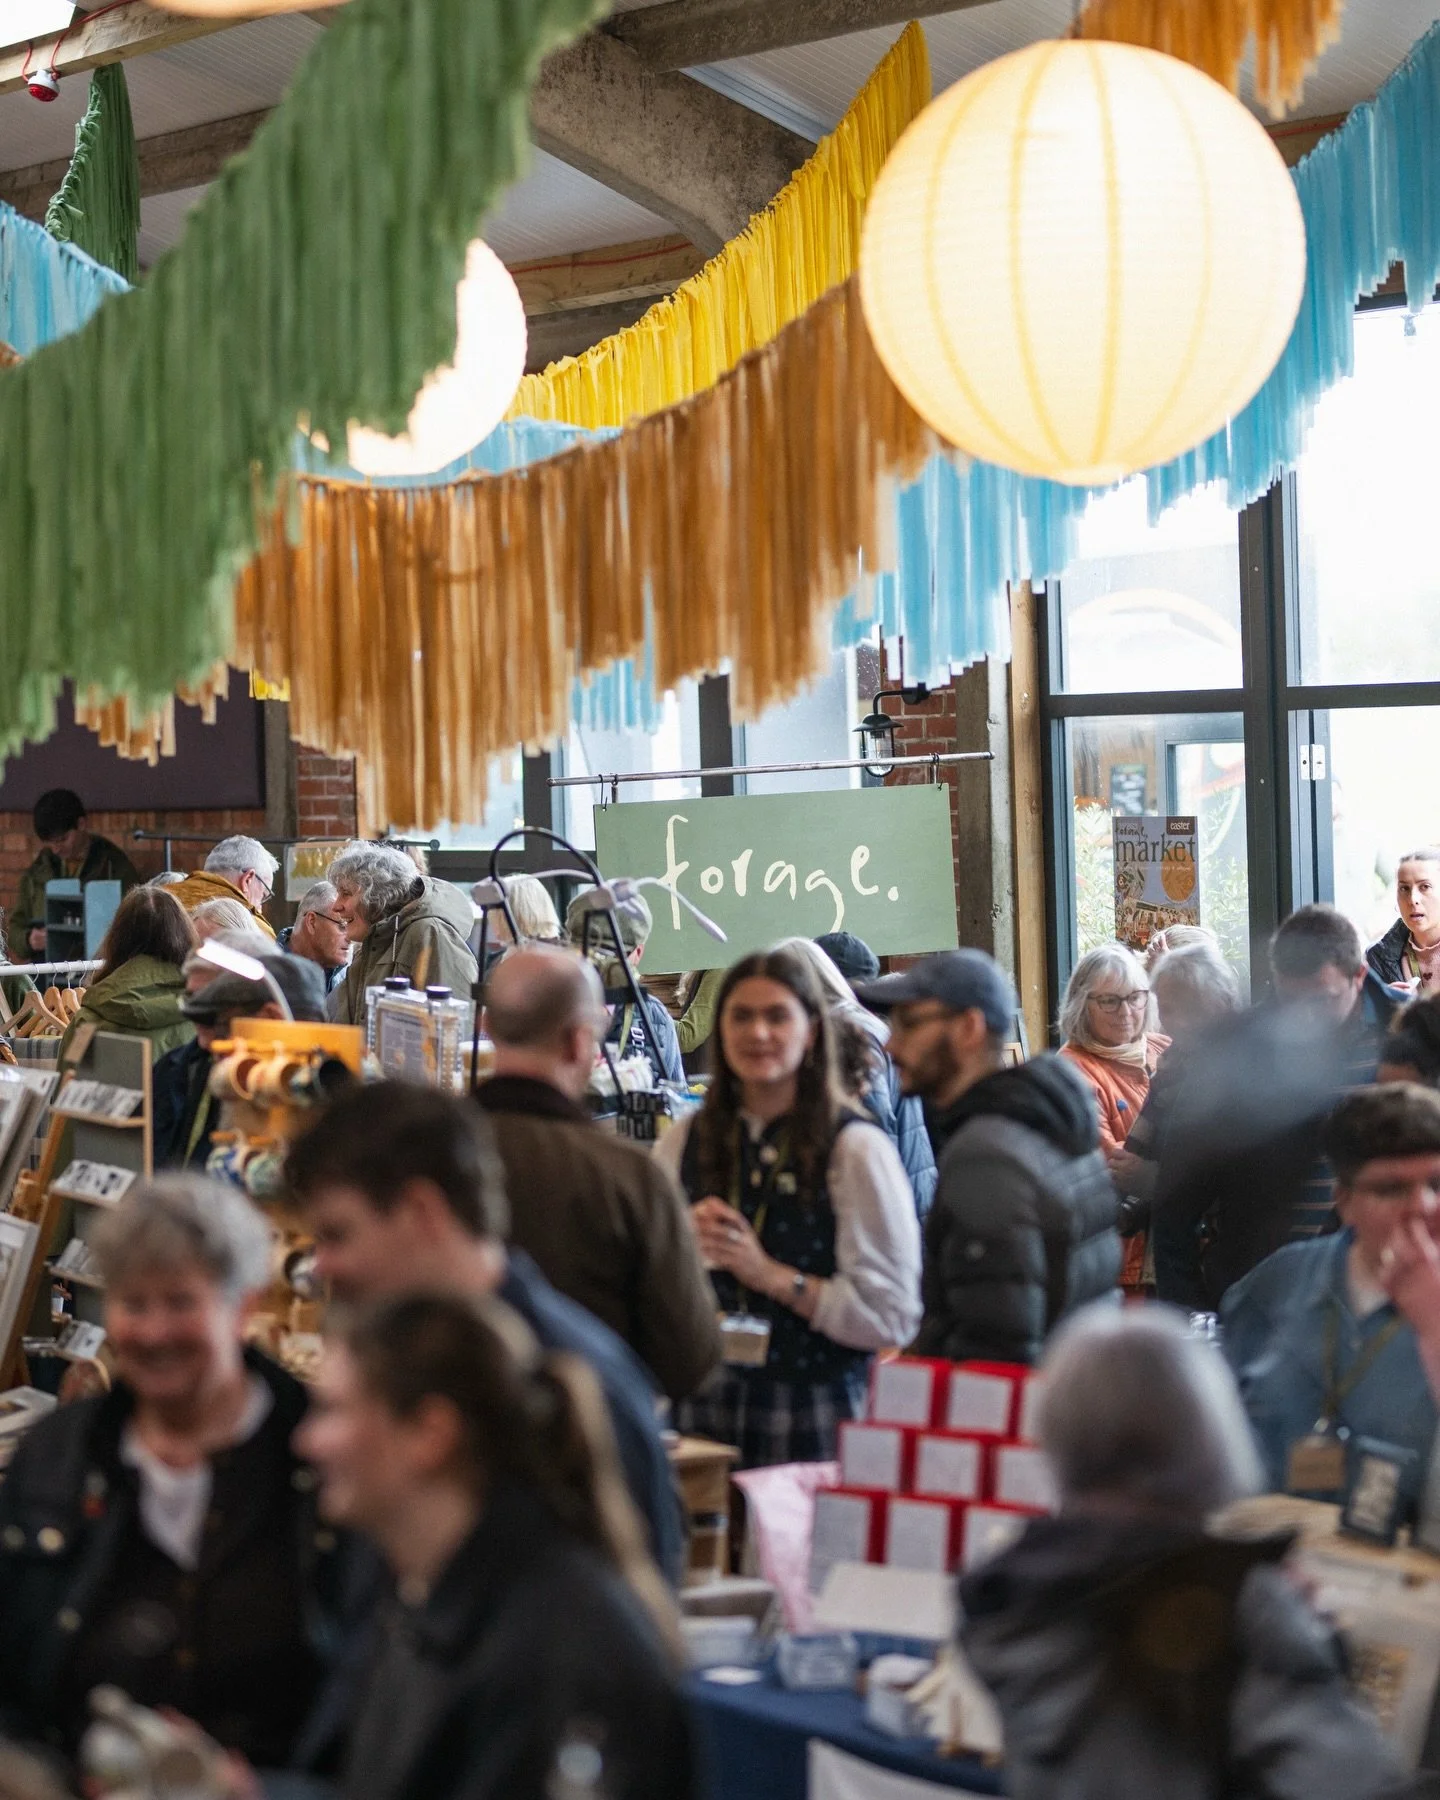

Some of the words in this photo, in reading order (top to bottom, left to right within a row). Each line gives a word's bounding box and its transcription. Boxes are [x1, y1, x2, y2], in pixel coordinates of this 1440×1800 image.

[1170, 822, 1190, 831] easter
[1115, 832, 1196, 862] market
[657, 814, 899, 933] forage.
